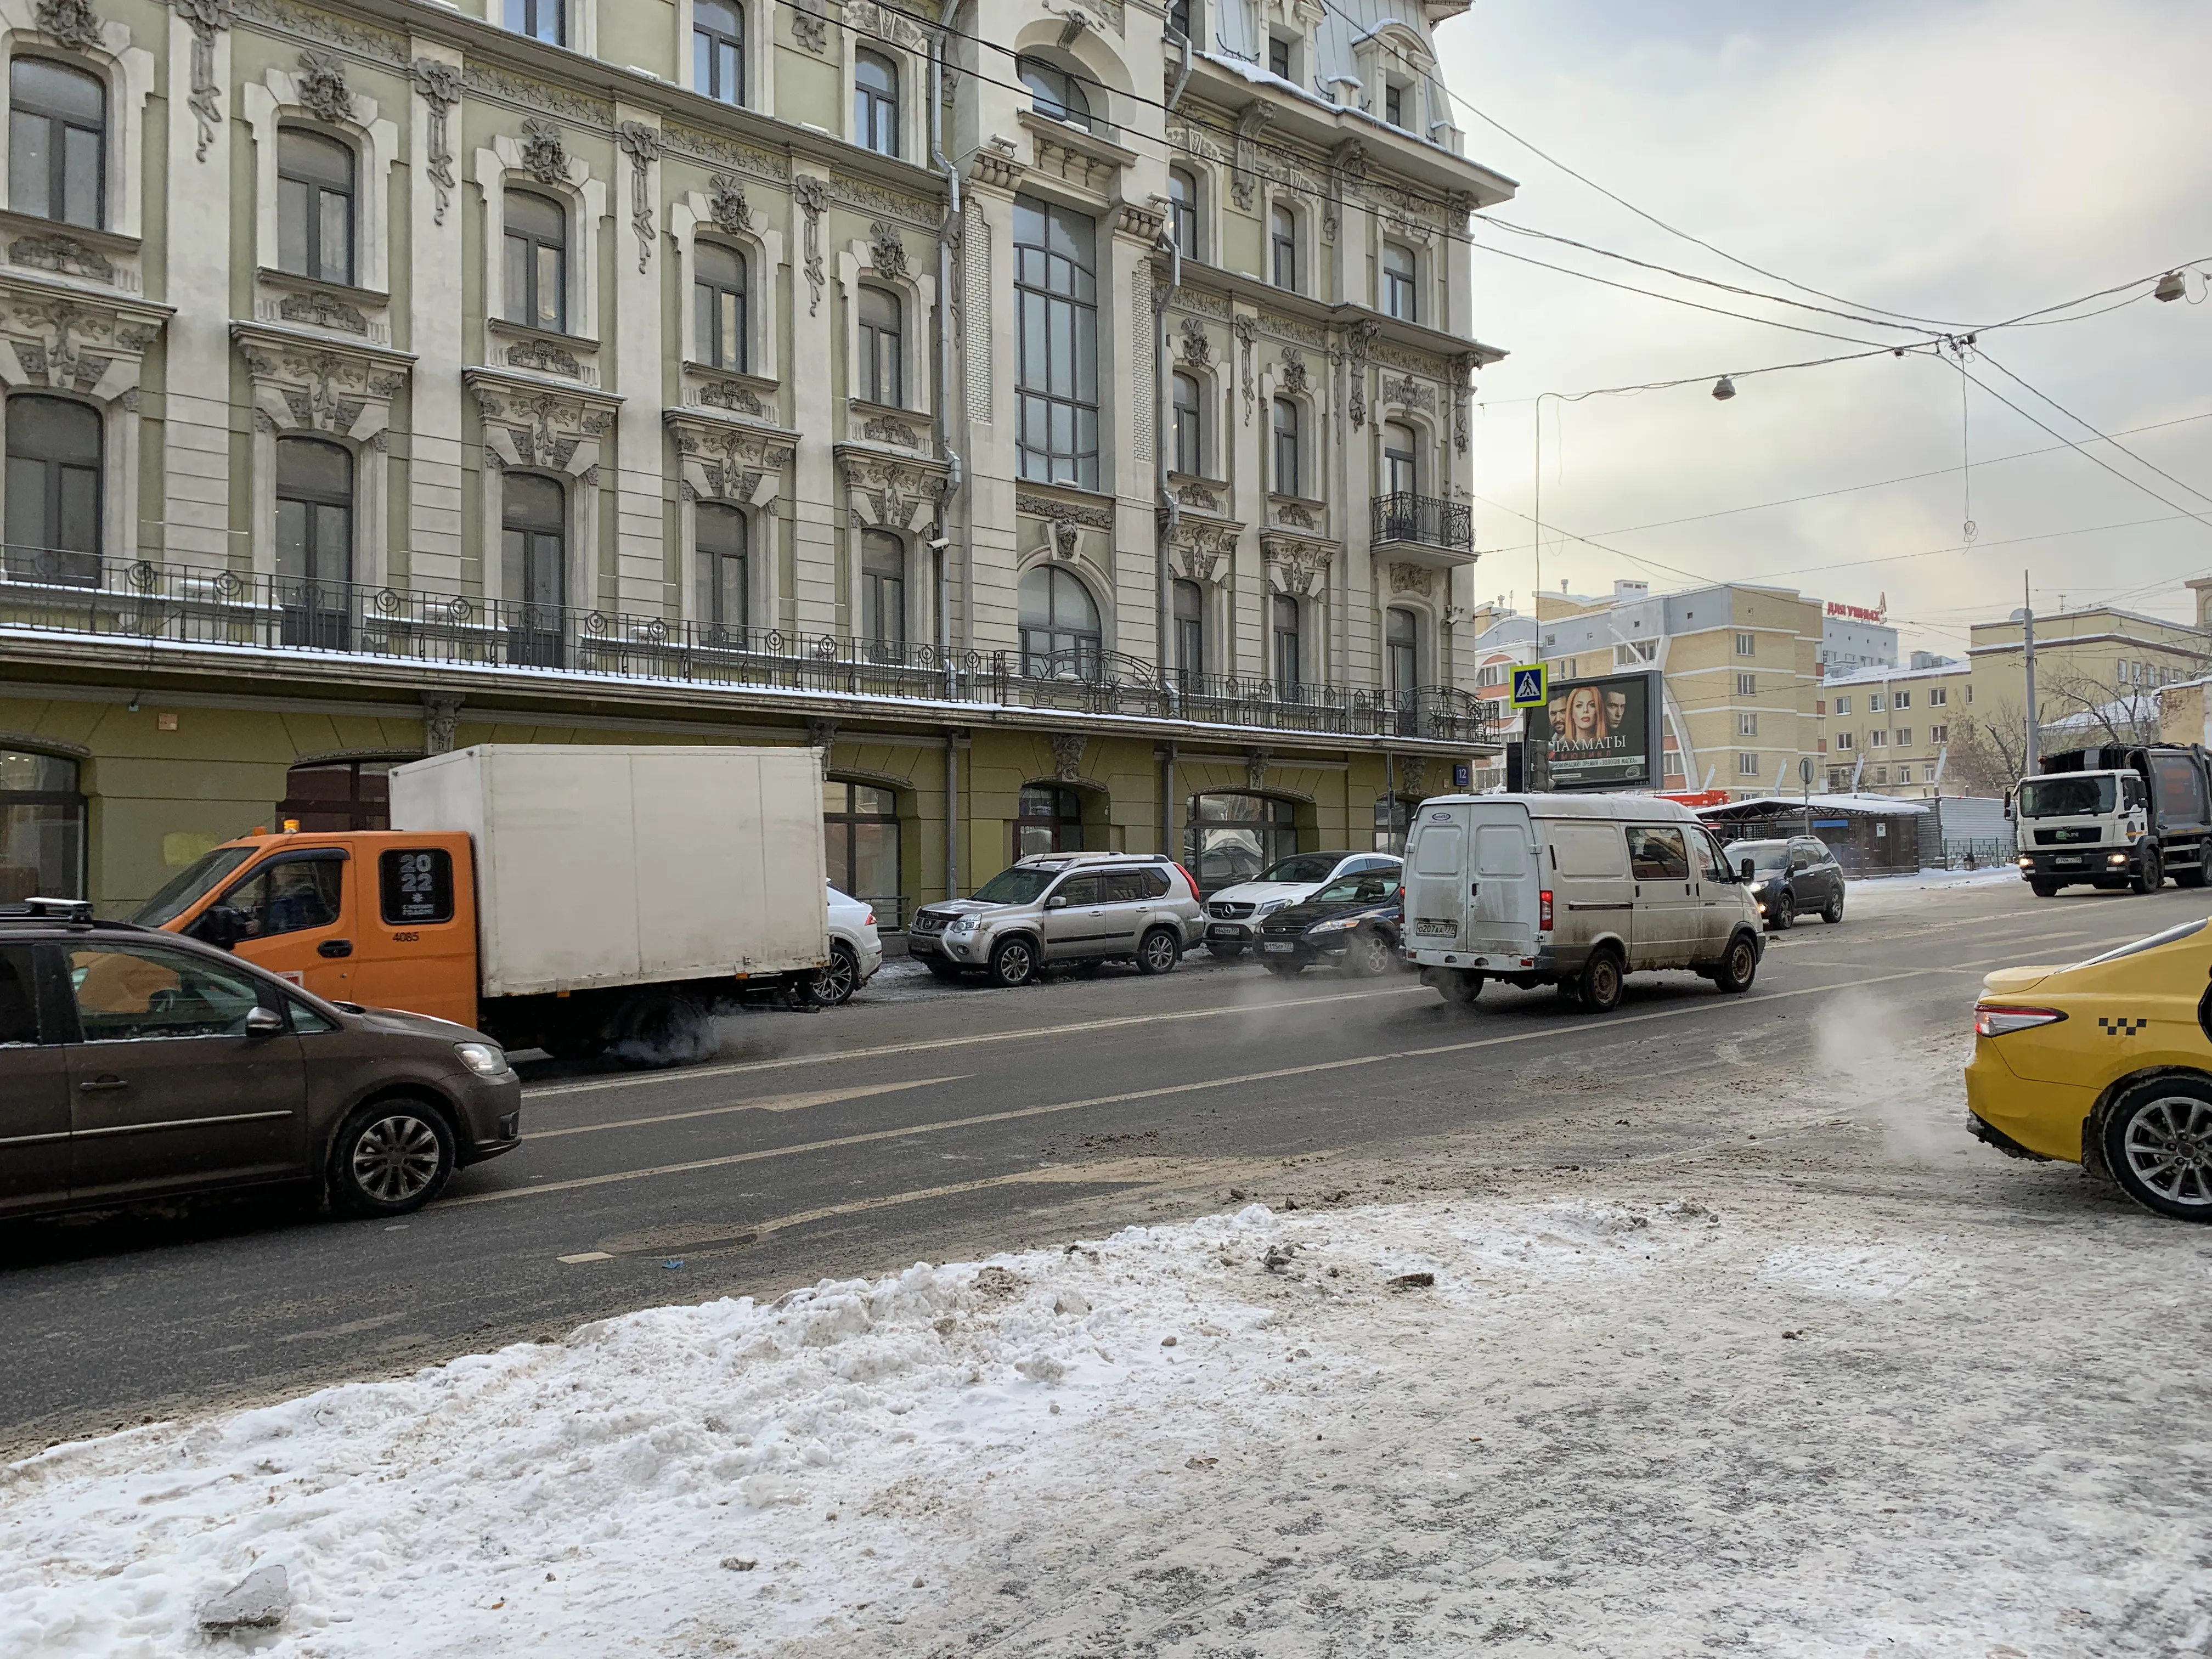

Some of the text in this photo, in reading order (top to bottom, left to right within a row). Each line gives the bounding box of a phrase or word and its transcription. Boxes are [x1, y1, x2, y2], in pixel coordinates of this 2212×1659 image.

[1827, 601, 1880, 622] ДЛЯ УМНЫХ
[1561, 750, 1612, 760] МЮЗИКЛ
[1459, 769, 1467, 778] 12
[400, 854, 431, 873] 20
[401, 873, 433, 892] 22
[392, 932, 420, 942] 4085
